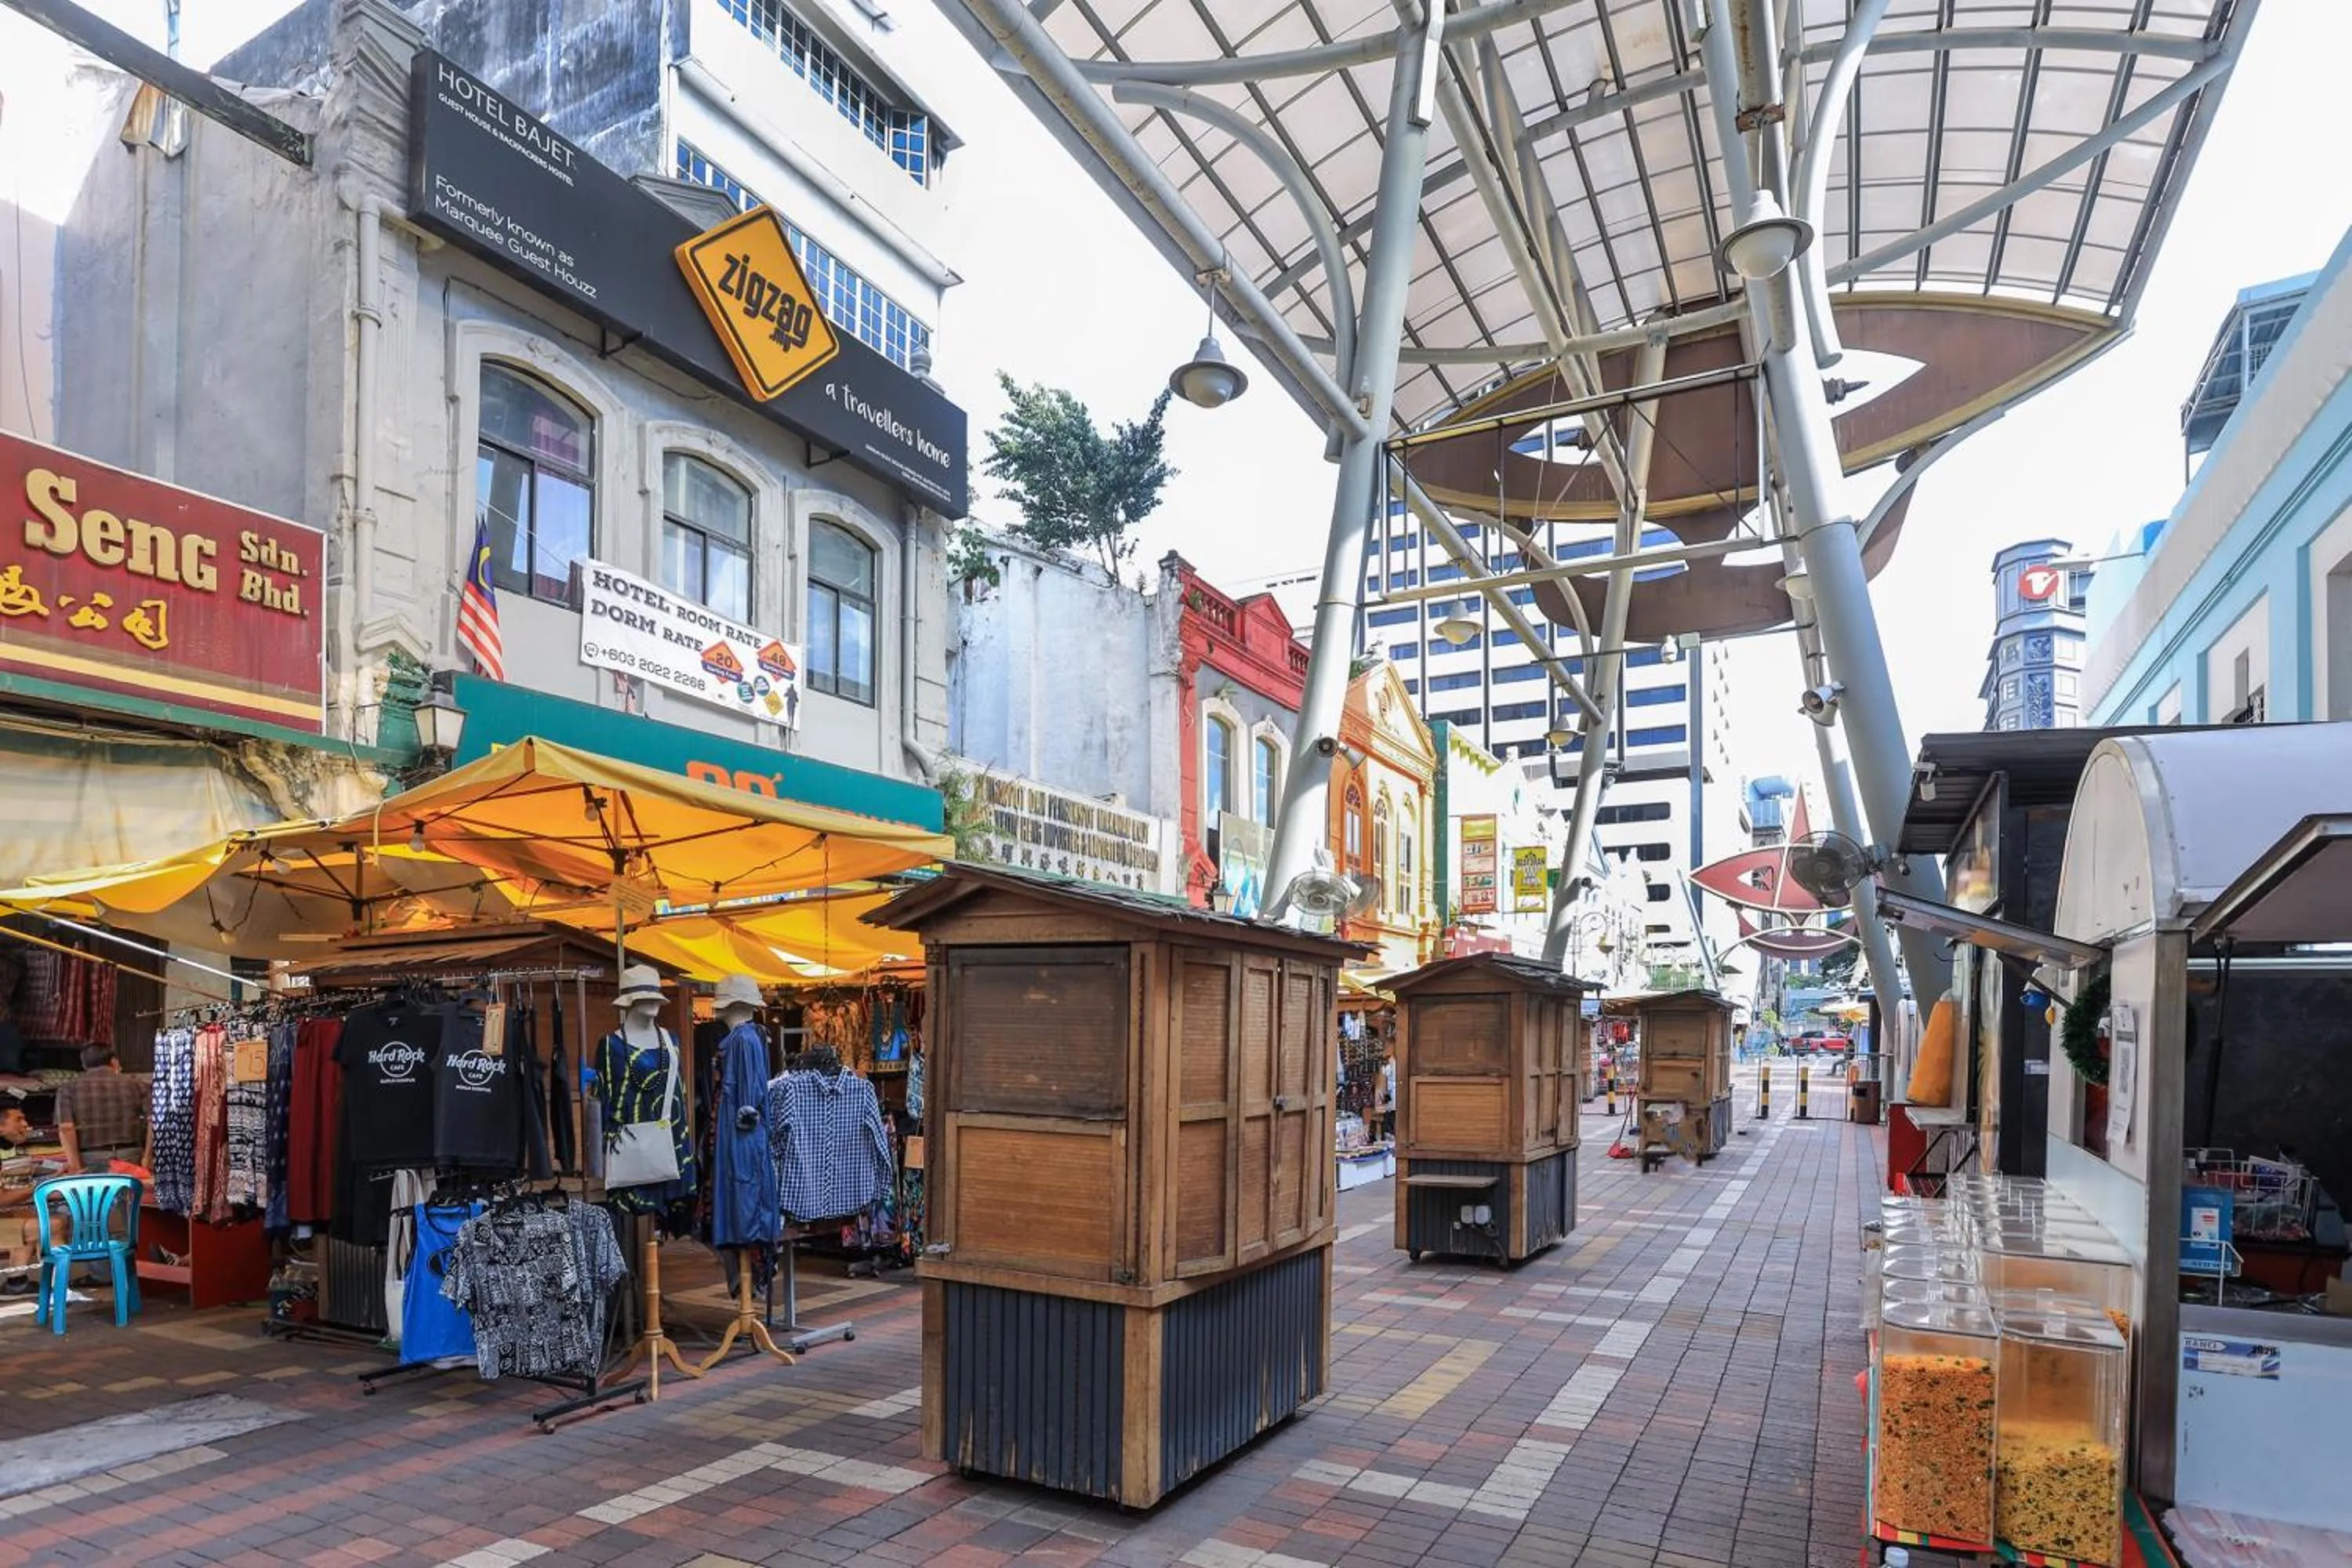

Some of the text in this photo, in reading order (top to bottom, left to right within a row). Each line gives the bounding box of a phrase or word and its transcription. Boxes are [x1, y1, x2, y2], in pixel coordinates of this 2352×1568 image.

[438, 63, 575, 167] HOTEL BAJET
[438, 93, 464, 114] GUEST
[465, 109, 492, 132] HOUSE
[499, 132, 548, 169] BACKPACKERS
[548, 165, 575, 187] HOSTEL
[434, 195, 597, 299] Marquee Guest Houzz
[435, 174, 575, 267] Formerly known as
[718, 252, 813, 349] zigzag
[826, 383, 951, 469] a travellers home
[240, 529, 308, 577] Sdn.
[240, 568, 310, 618] Bhd.
[591, 598, 703, 652] DORM RATE
[593, 570, 762, 649] HOTEL ROOM RATE
[601, 648, 636, 666] +603
[639, 658, 670, 680] 2022
[368, 1047, 426, 1064] Hard Rock
[446, 1054, 507, 1075] Hard Rock
